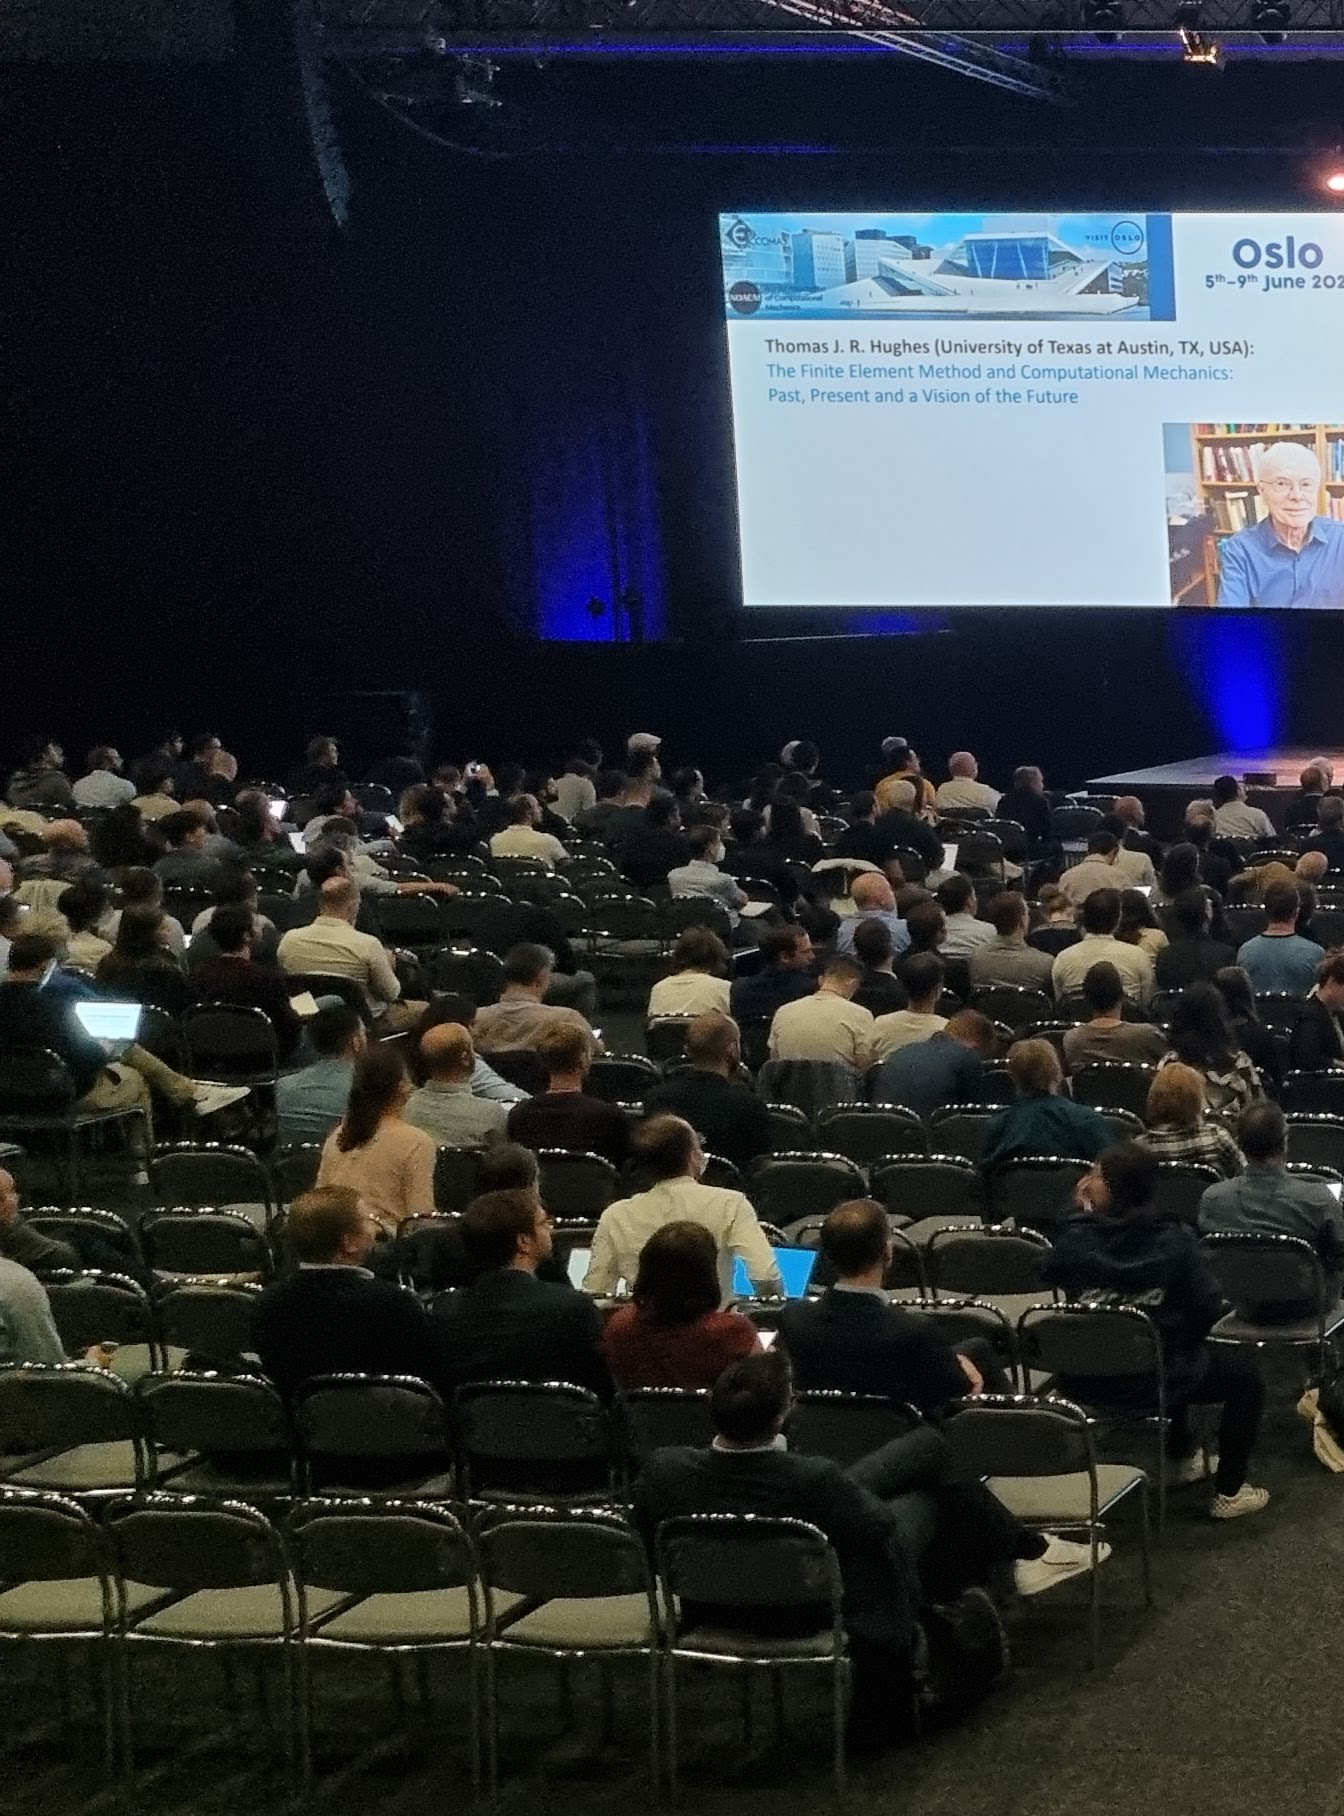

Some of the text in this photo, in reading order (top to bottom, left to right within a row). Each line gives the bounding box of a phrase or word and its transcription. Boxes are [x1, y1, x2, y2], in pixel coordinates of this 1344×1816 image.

[1233, 236, 1323, 268] Oslo
[1262, 275, 1306, 292] June
[764, 338, 1254, 358] Thomas J. R. Hughes (University of Texas at Austin, TX, USA):
[766, 363, 1232, 382] The Finite Element Method and Computational Mechanics:
[769, 388, 1078, 404] Past, Present and a Vision of the Future
